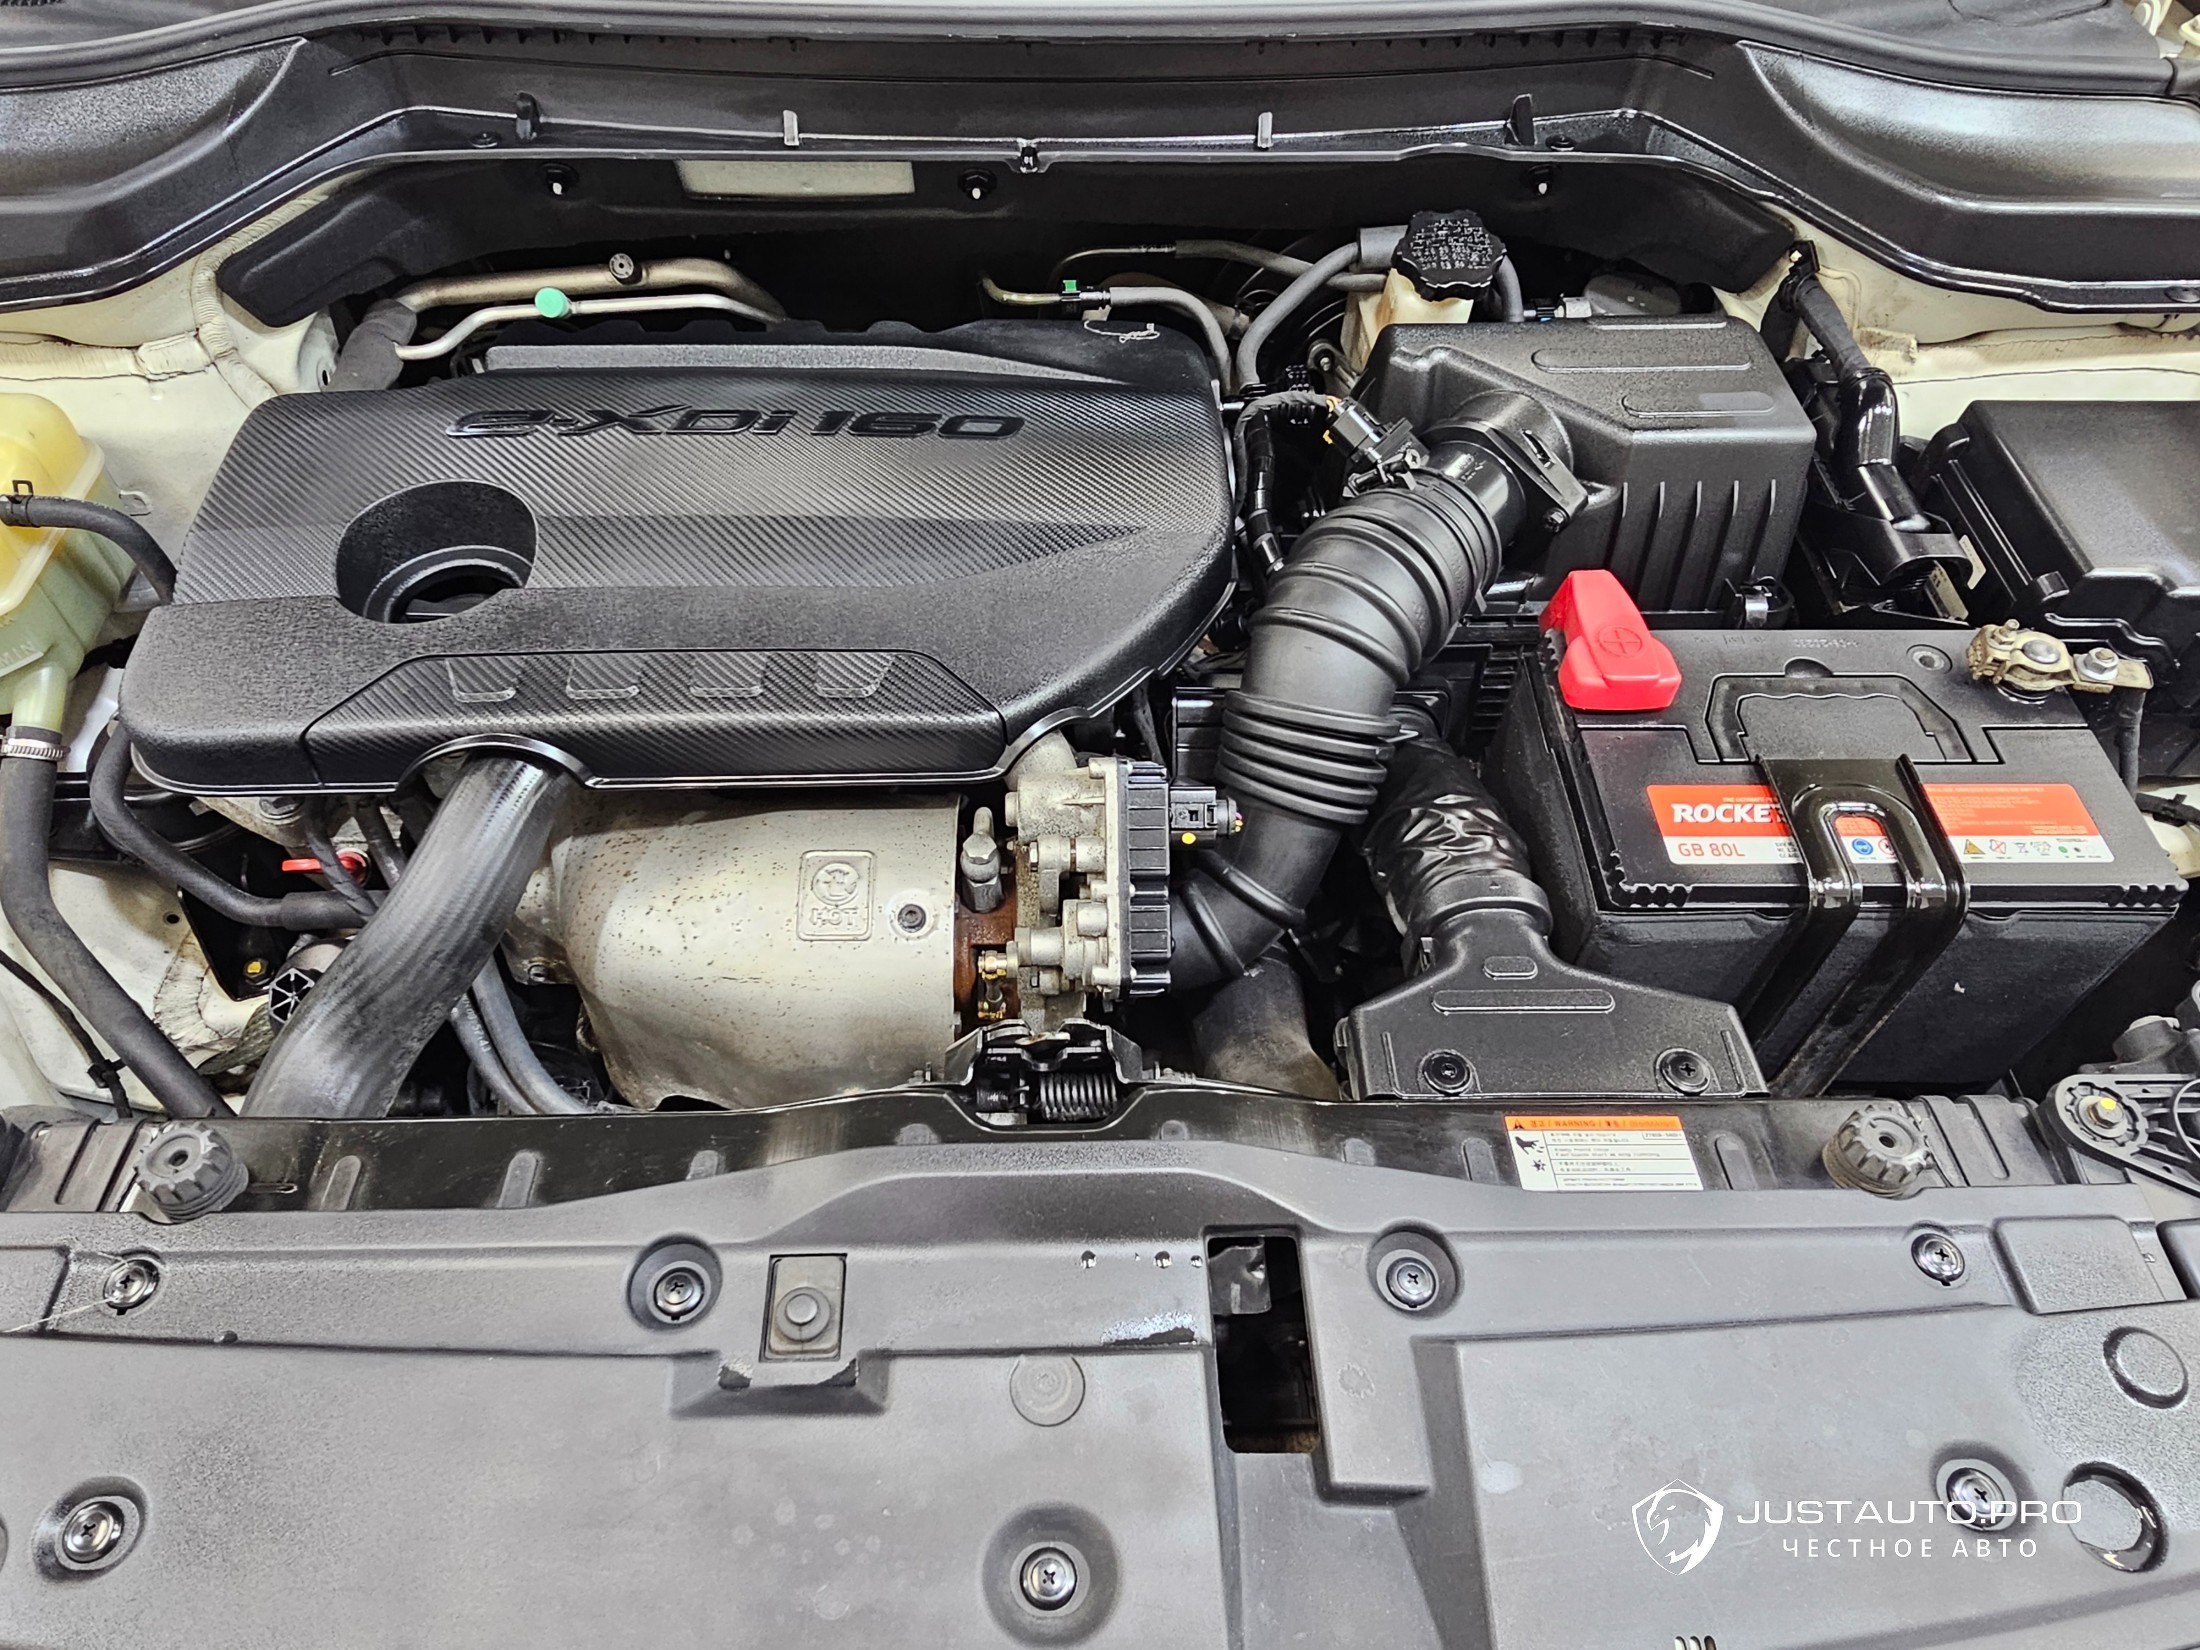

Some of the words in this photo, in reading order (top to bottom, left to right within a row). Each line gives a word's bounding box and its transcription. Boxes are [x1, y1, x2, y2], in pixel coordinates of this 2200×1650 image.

[810, 410, 1026, 440] 160
[1678, 843, 1704, 857] GB
[1709, 843, 1746, 857] 80L
[809, 907, 858, 926] HOT
[1554, 1120, 1597, 1128] WARNING
